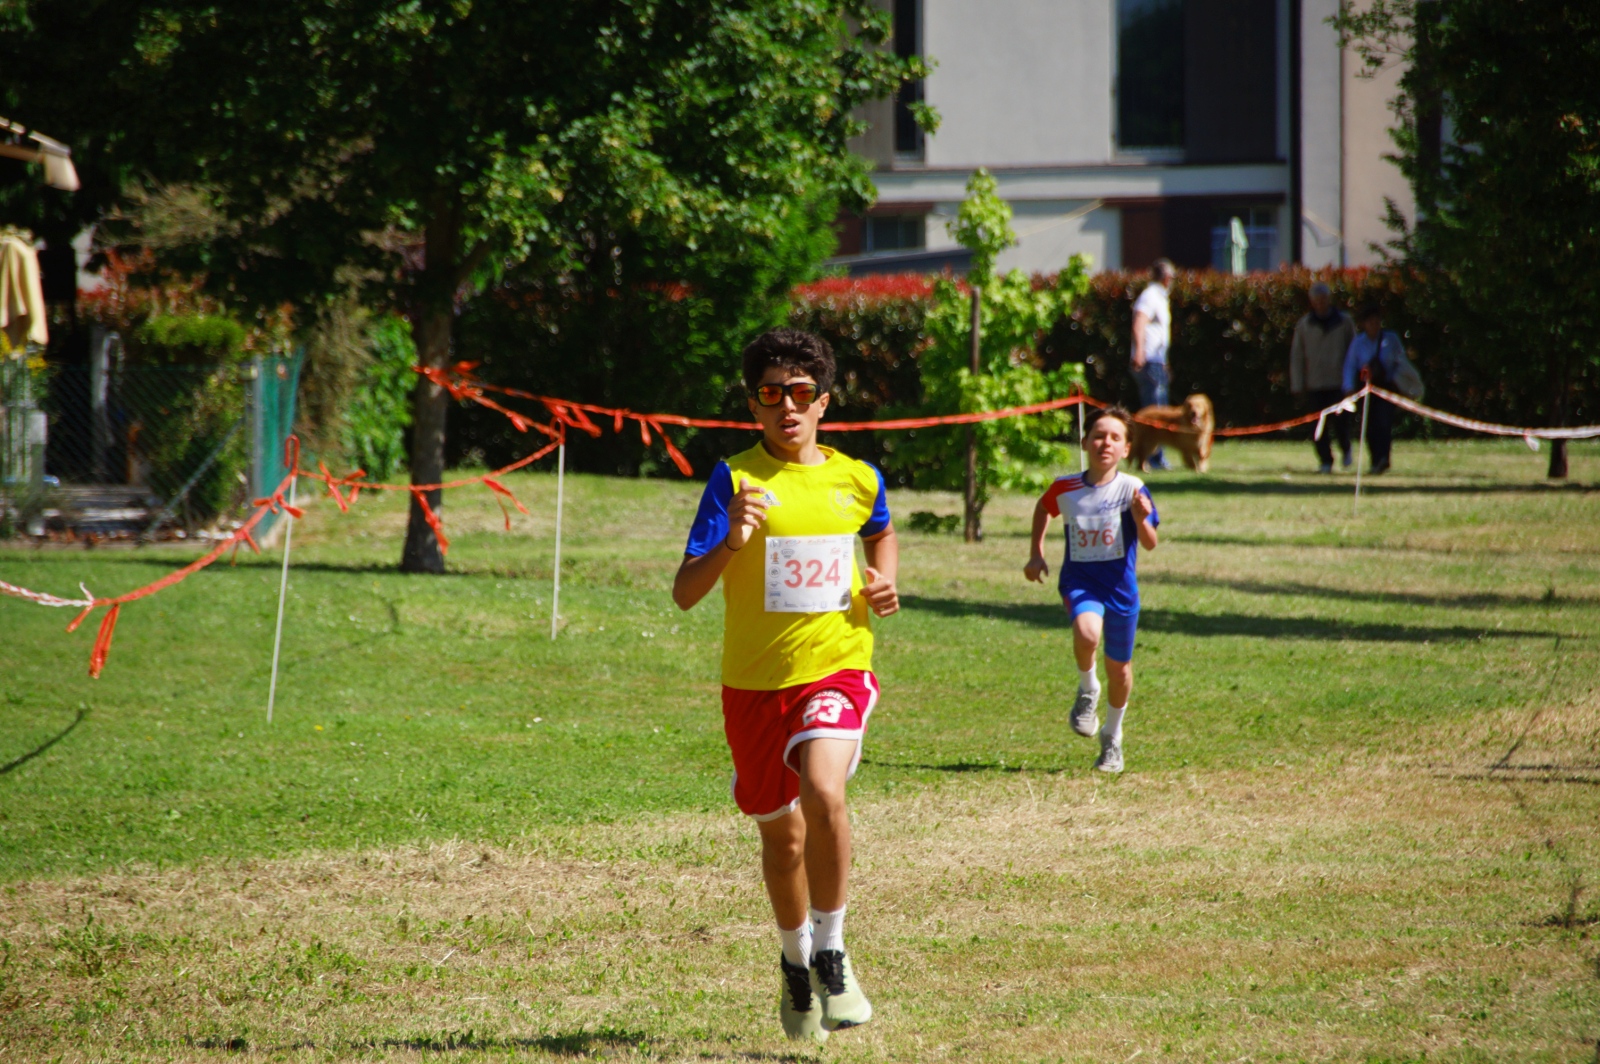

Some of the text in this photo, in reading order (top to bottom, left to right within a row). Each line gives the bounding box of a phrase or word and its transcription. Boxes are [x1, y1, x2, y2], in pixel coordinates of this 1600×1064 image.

[1077, 529, 1114, 547] 376
[784, 559, 840, 588] 324
[802, 698, 843, 727] 23
